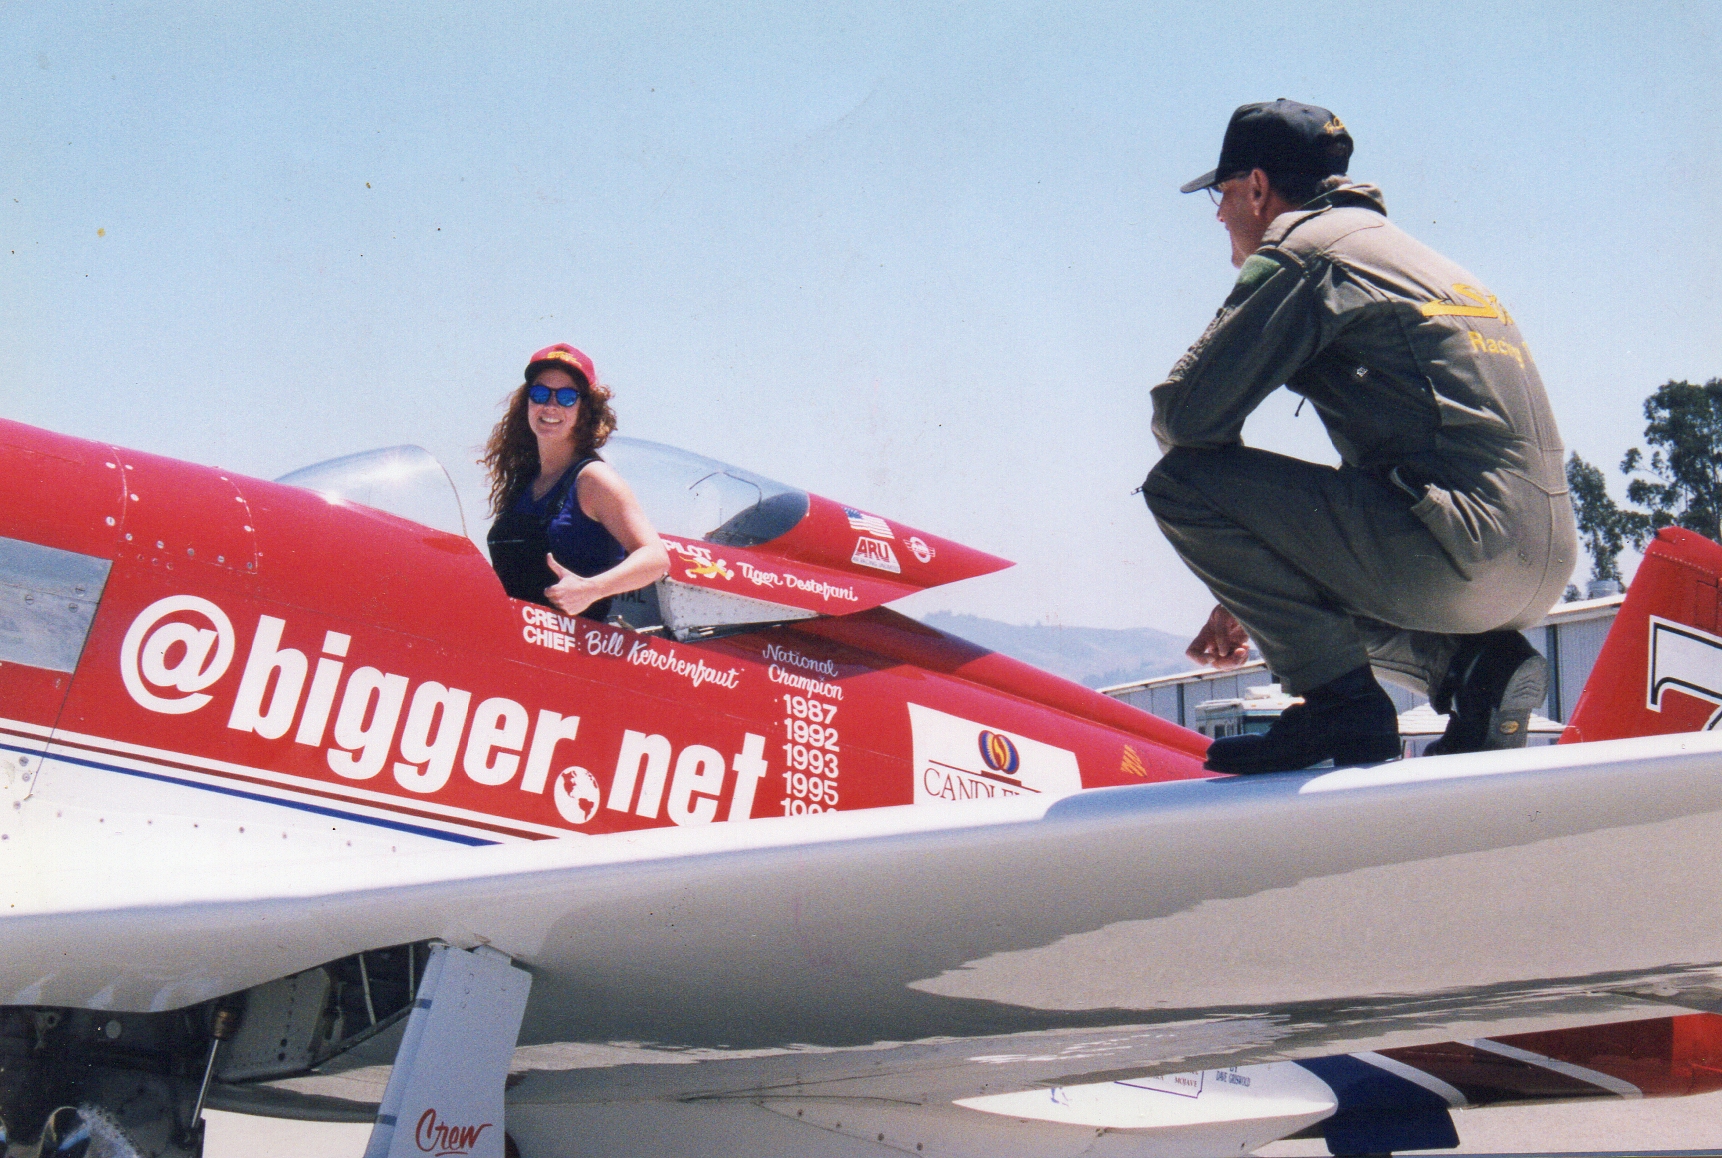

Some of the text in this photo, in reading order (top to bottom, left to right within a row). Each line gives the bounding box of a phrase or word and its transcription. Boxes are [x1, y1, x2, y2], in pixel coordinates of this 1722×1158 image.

[661, 538, 712, 561] PILOT
[855, 538, 890, 563] ARU
[736, 561, 858, 602] Tiger Destefani
[522, 606, 576, 634] CREW
[585, 630, 740, 689] Bill Kerchenfaut
[762, 643, 838, 677] National
[768, 663, 844, 701] Champion
[783, 693, 838, 724] 1987
[783, 717, 840, 752] 1992
[782, 742, 839, 778] 1993
[782, 770, 839, 805] 1995
[415, 1108, 493, 1152] Crew
